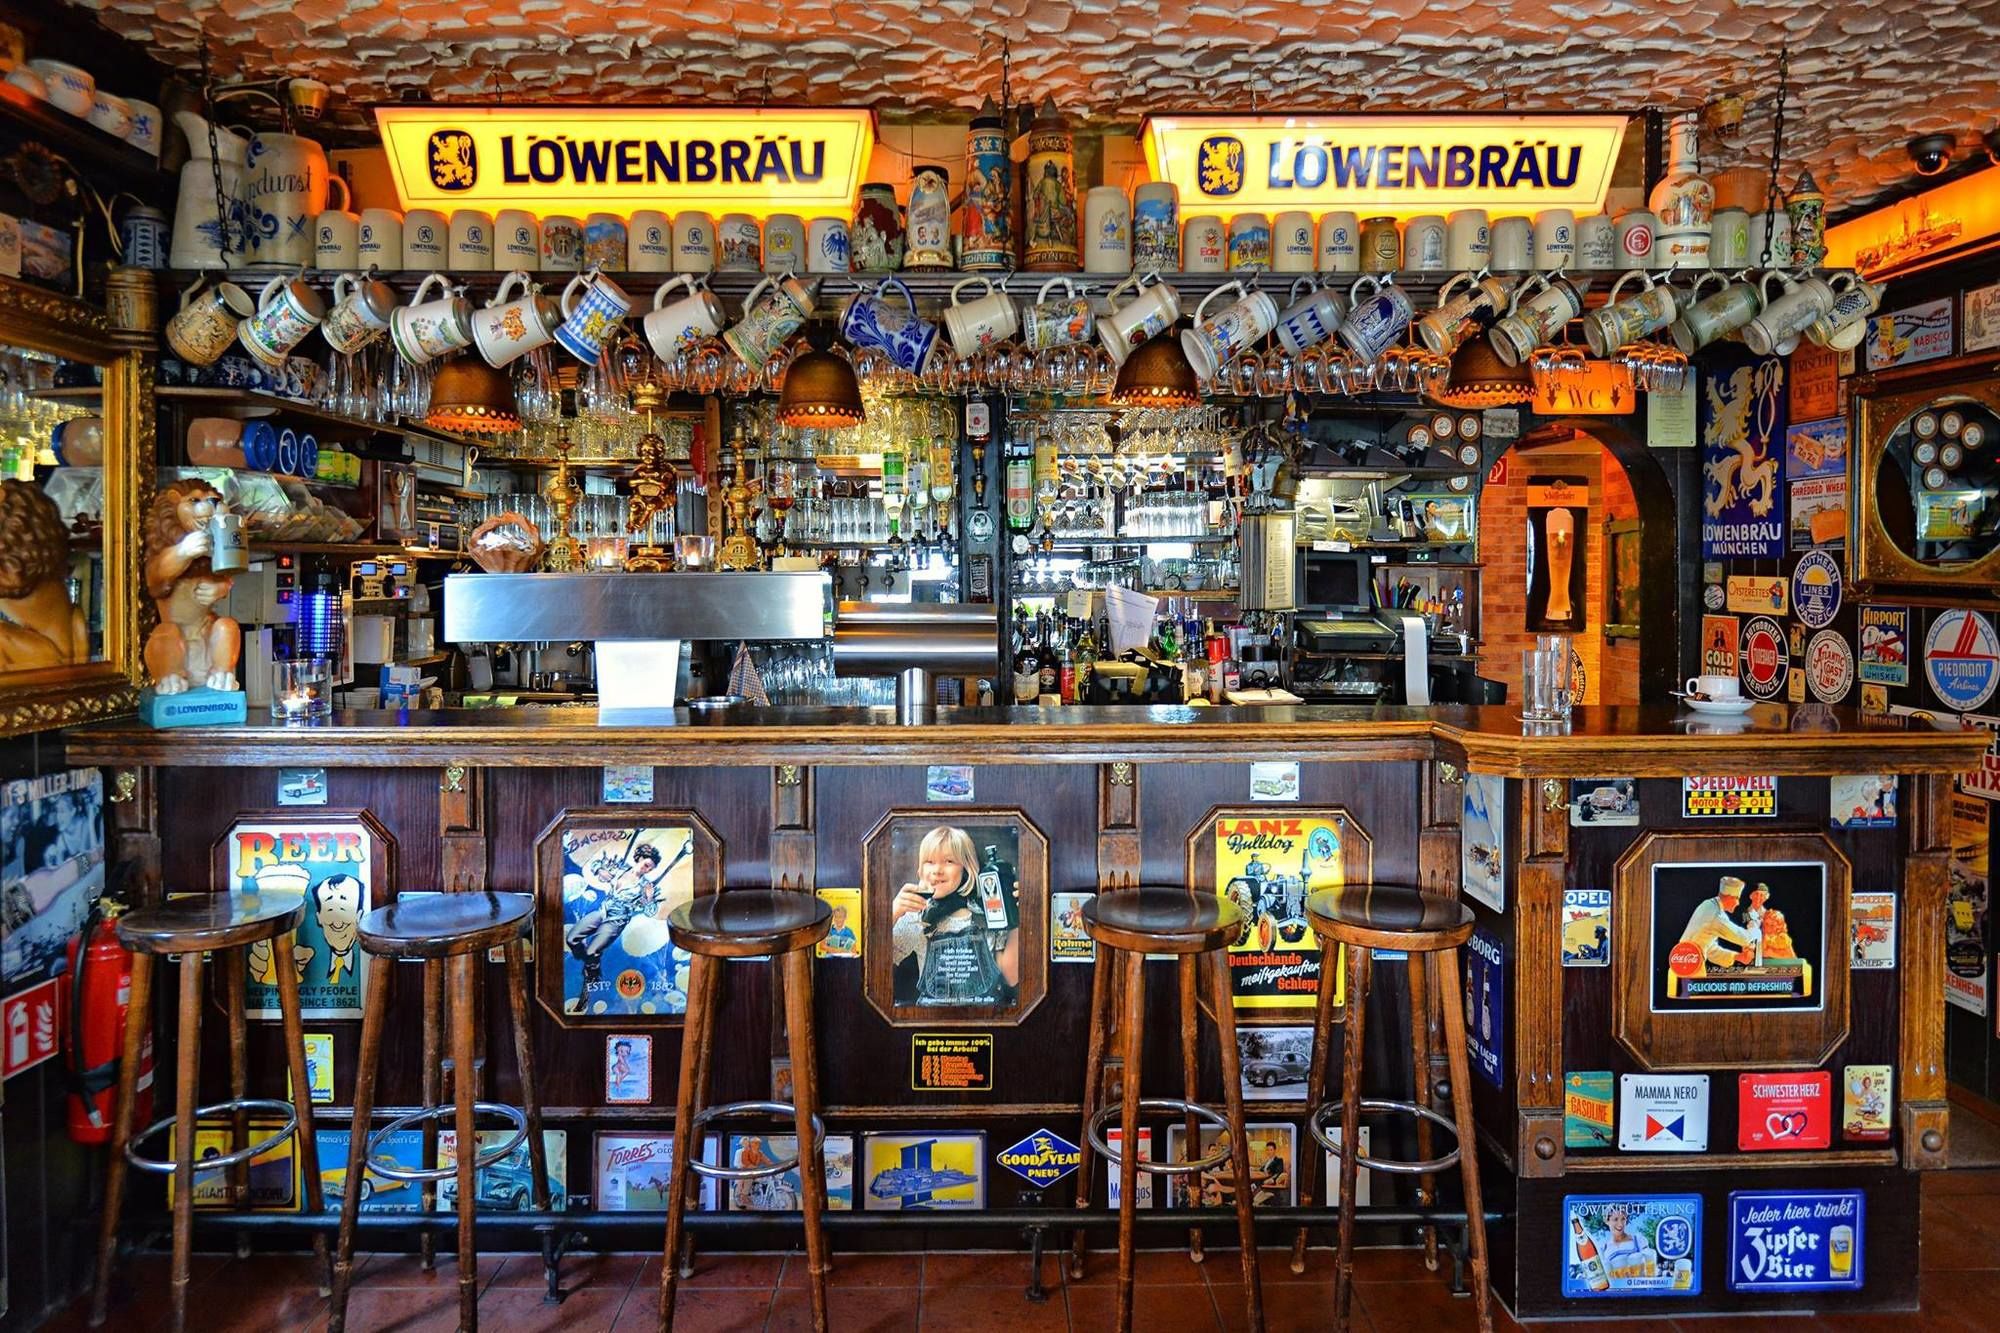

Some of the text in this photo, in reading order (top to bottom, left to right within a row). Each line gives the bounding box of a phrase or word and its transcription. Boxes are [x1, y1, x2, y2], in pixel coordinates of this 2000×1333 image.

[501, 134, 827, 184] LÖWENBRÄU
[1267, 140, 1582, 190] LÖWENBRÄU
[1913, 331, 1950, 347] NABISCO
[1568, 388, 1601, 409] WC
[1792, 484, 1824, 497] SHREDDED
[1825, 482, 1847, 494] WHEA
[1702, 521, 1783, 544] LÖWENBRÄU
[1712, 539, 1768, 555] MÜNCHEN
[1796, 553, 1839, 583] SOUTHERN
[1803, 585, 1830, 596] LINES
[1797, 603, 1834, 625] PACIFIC
[1860, 607, 1906, 632] AIRPORT
[1745, 620, 1782, 644] AUTHORIZED
[1706, 650, 1734, 668] GOLD
[1864, 670, 1903, 683] WHISKEY
[1938, 662, 1988, 678] PIEDMONT
[1745, 673, 1780, 694] SERVICE
[176, 702, 239, 716] LÖWENBRÄU
[1689, 775, 1773, 790] SPEEDWELL
[1691, 798, 1769, 808] MOTOR OIL
[1218, 819, 1303, 837] LANZ
[566, 830, 634, 853] BACARDI
[1226, 833, 1295, 855] Bulldog
[235, 830, 365, 879] BEER
[1565, 892, 1609, 905] OPEL
[1228, 953, 1302, 967] Deutschlands
[1670, 953, 1700, 964] Coca-Cola
[298, 986, 318, 996] GLY
[320, 986, 358, 996] PEOPLE
[1277, 979, 1319, 992] Schlepp
[1687, 981, 1793, 993] DELICIOUS AND REFRESHING
[300, 998, 328, 1007] SINCE
[1634, 1086, 1698, 1100] MAMMA NERO
[1752, 1083, 1820, 1098] SCHWESTER HERZ
[1570, 1096, 1609, 1123] GASOLINE
[408, 1135, 420, 1144] Car
[1002, 1152, 1040, 1166] GOOD
[1027, 1168, 1060, 1179] PNEUS
[1570, 1201, 1696, 1217] LÖWENFÜTTERUNG
[1741, 1198, 1854, 1225] Jeder hier trinkt
[1740, 1225, 1820, 1282] Zipfer
[1764, 1254, 1816, 1279] Bier
